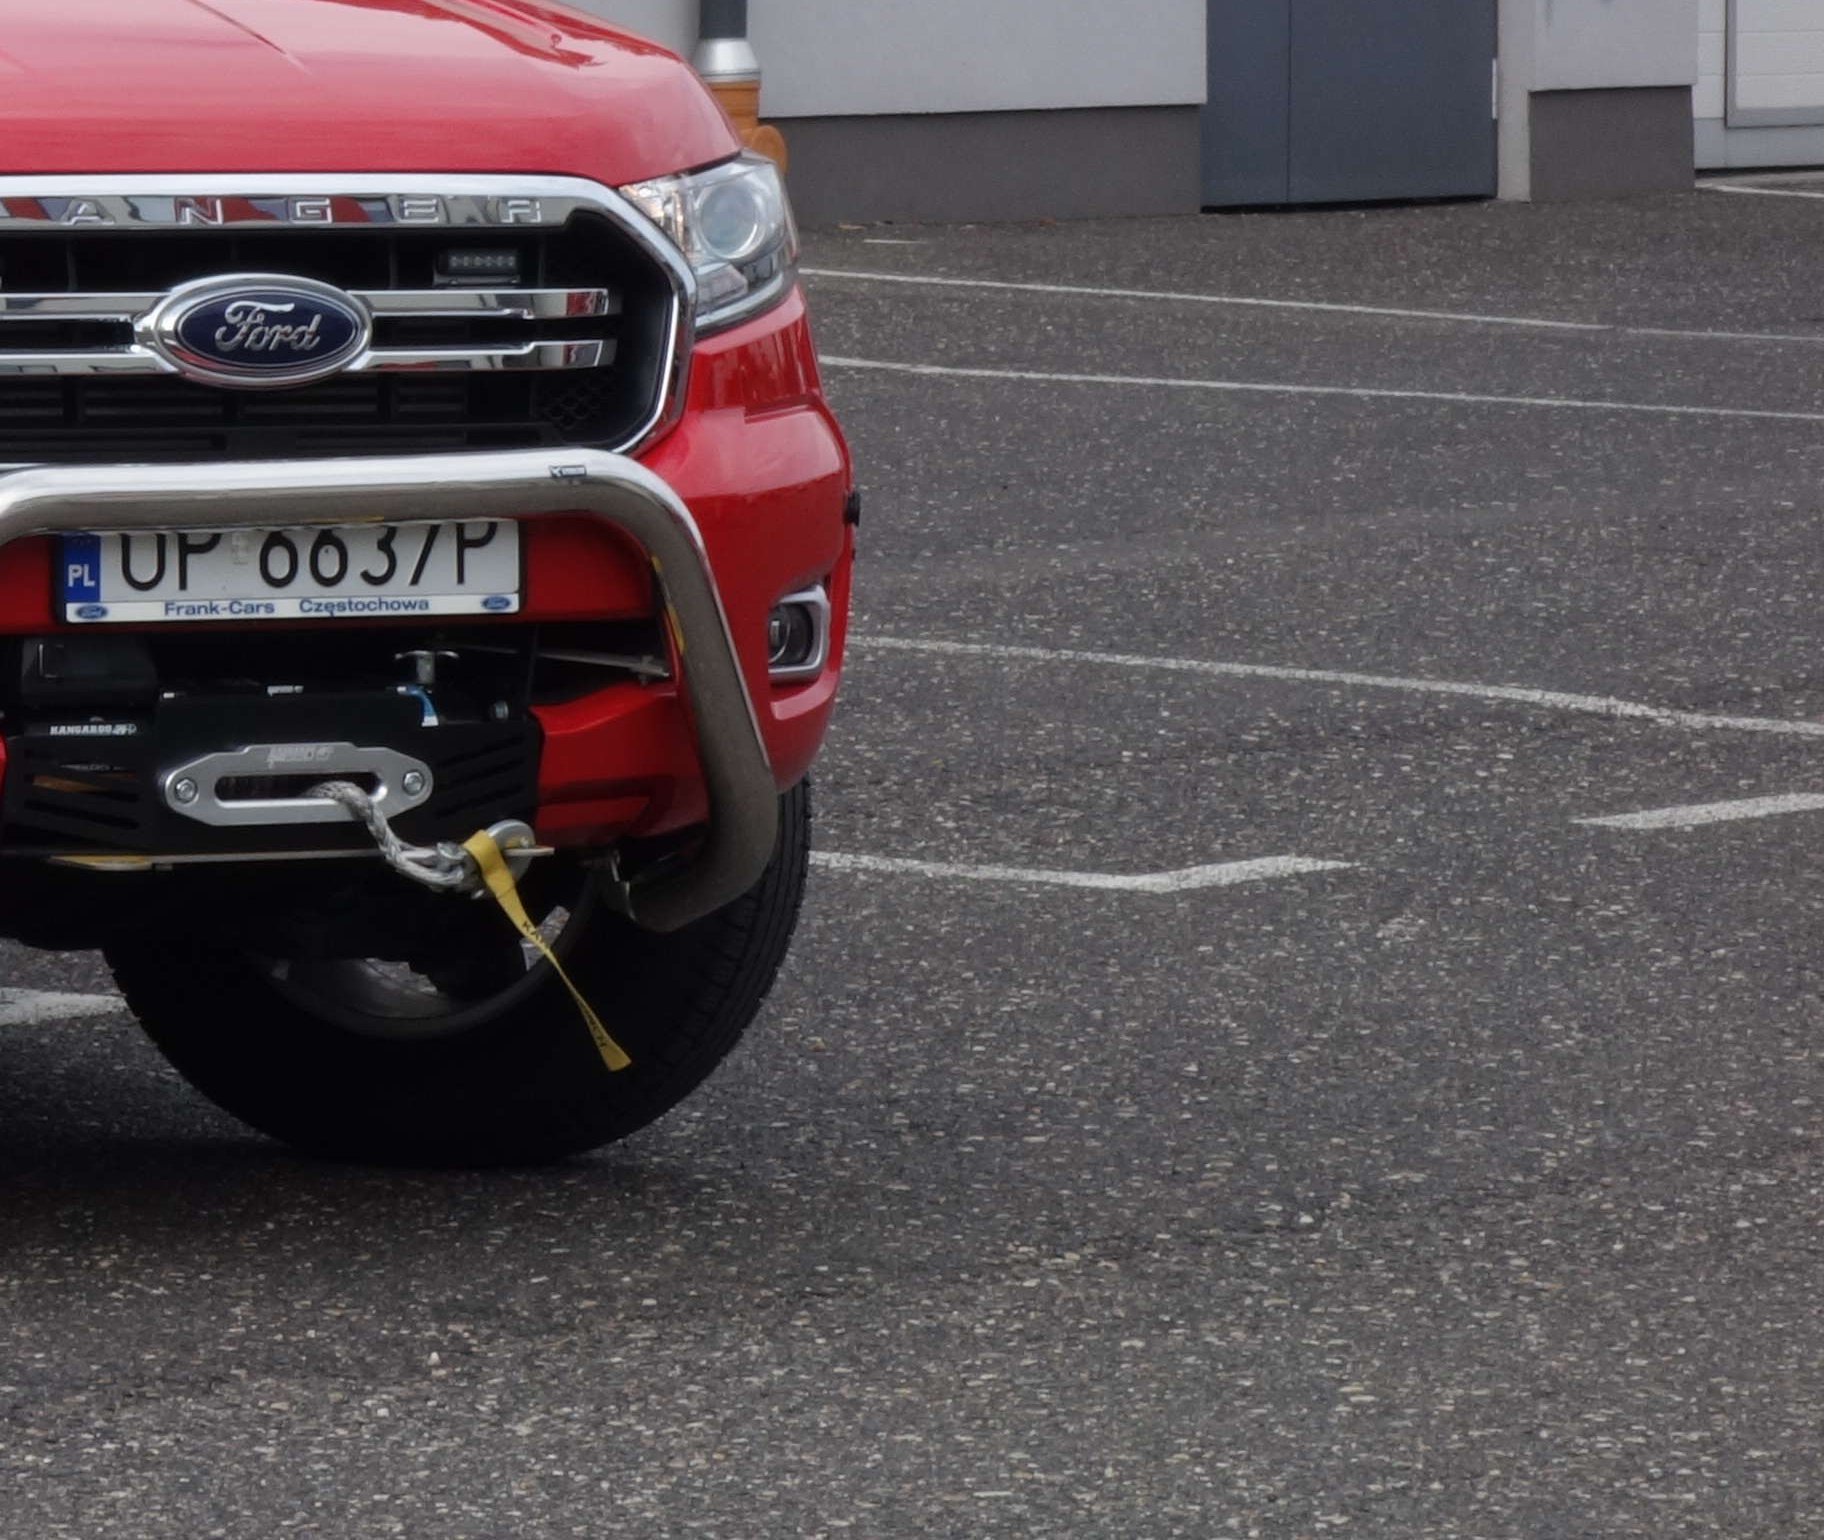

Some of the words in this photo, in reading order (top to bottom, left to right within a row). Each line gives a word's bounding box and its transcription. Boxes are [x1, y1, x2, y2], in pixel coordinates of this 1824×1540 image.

[214, 300, 322, 352] Ford
[66, 563, 96, 588] PL
[164, 600, 276, 616] Frank-Cars
[298, 598, 430, 617] Częstochowa
